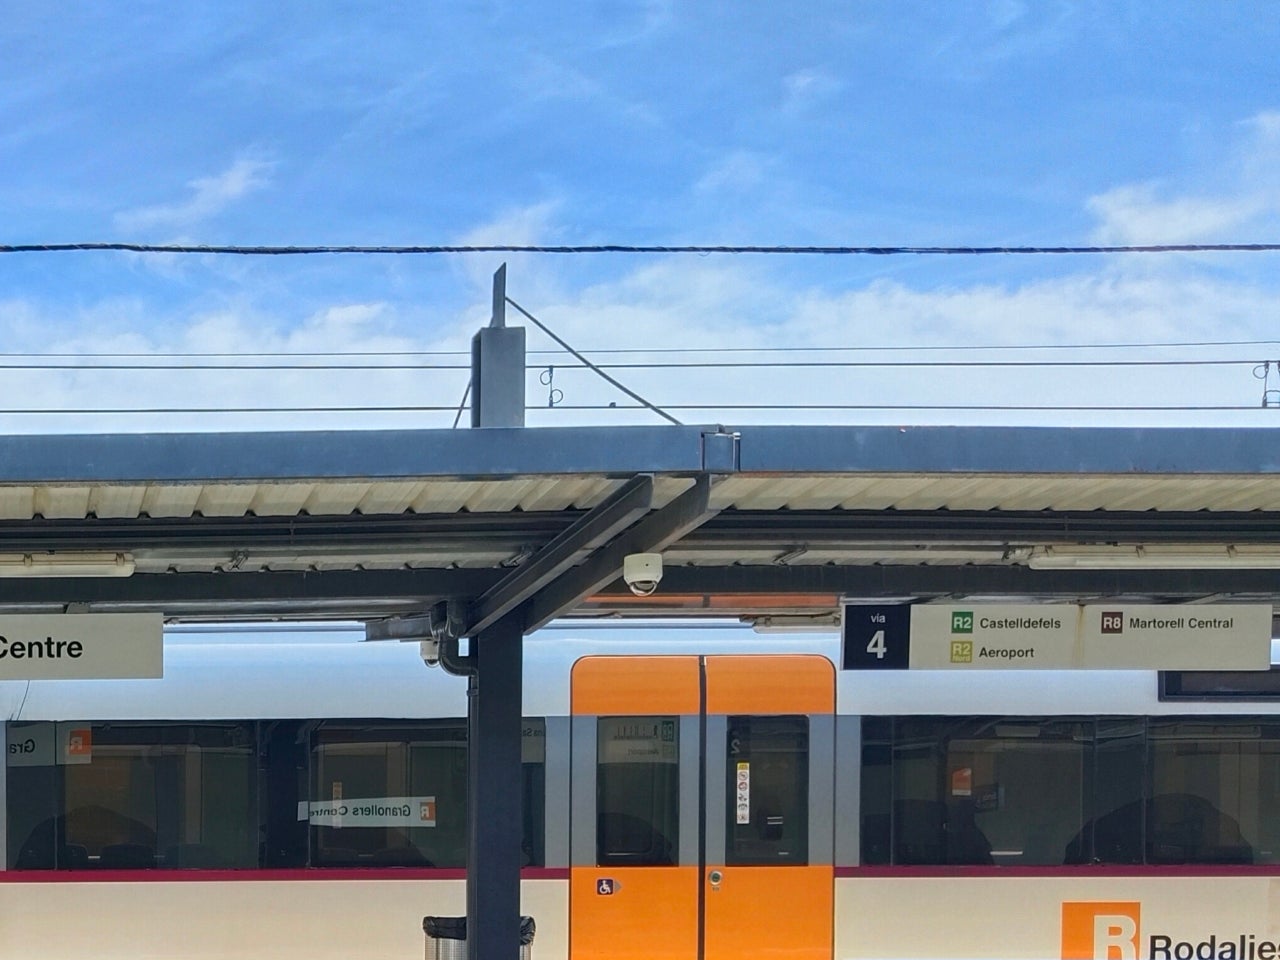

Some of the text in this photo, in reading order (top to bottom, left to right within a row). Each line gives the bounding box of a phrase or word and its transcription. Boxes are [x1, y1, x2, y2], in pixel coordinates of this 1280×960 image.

[953, 616, 1062, 629] R2 Castelldefels
[1103, 617, 1234, 629] R8 Martorell Central
[866, 630, 887, 659] 4
[952, 642, 1035, 660] R2 Aeroport
